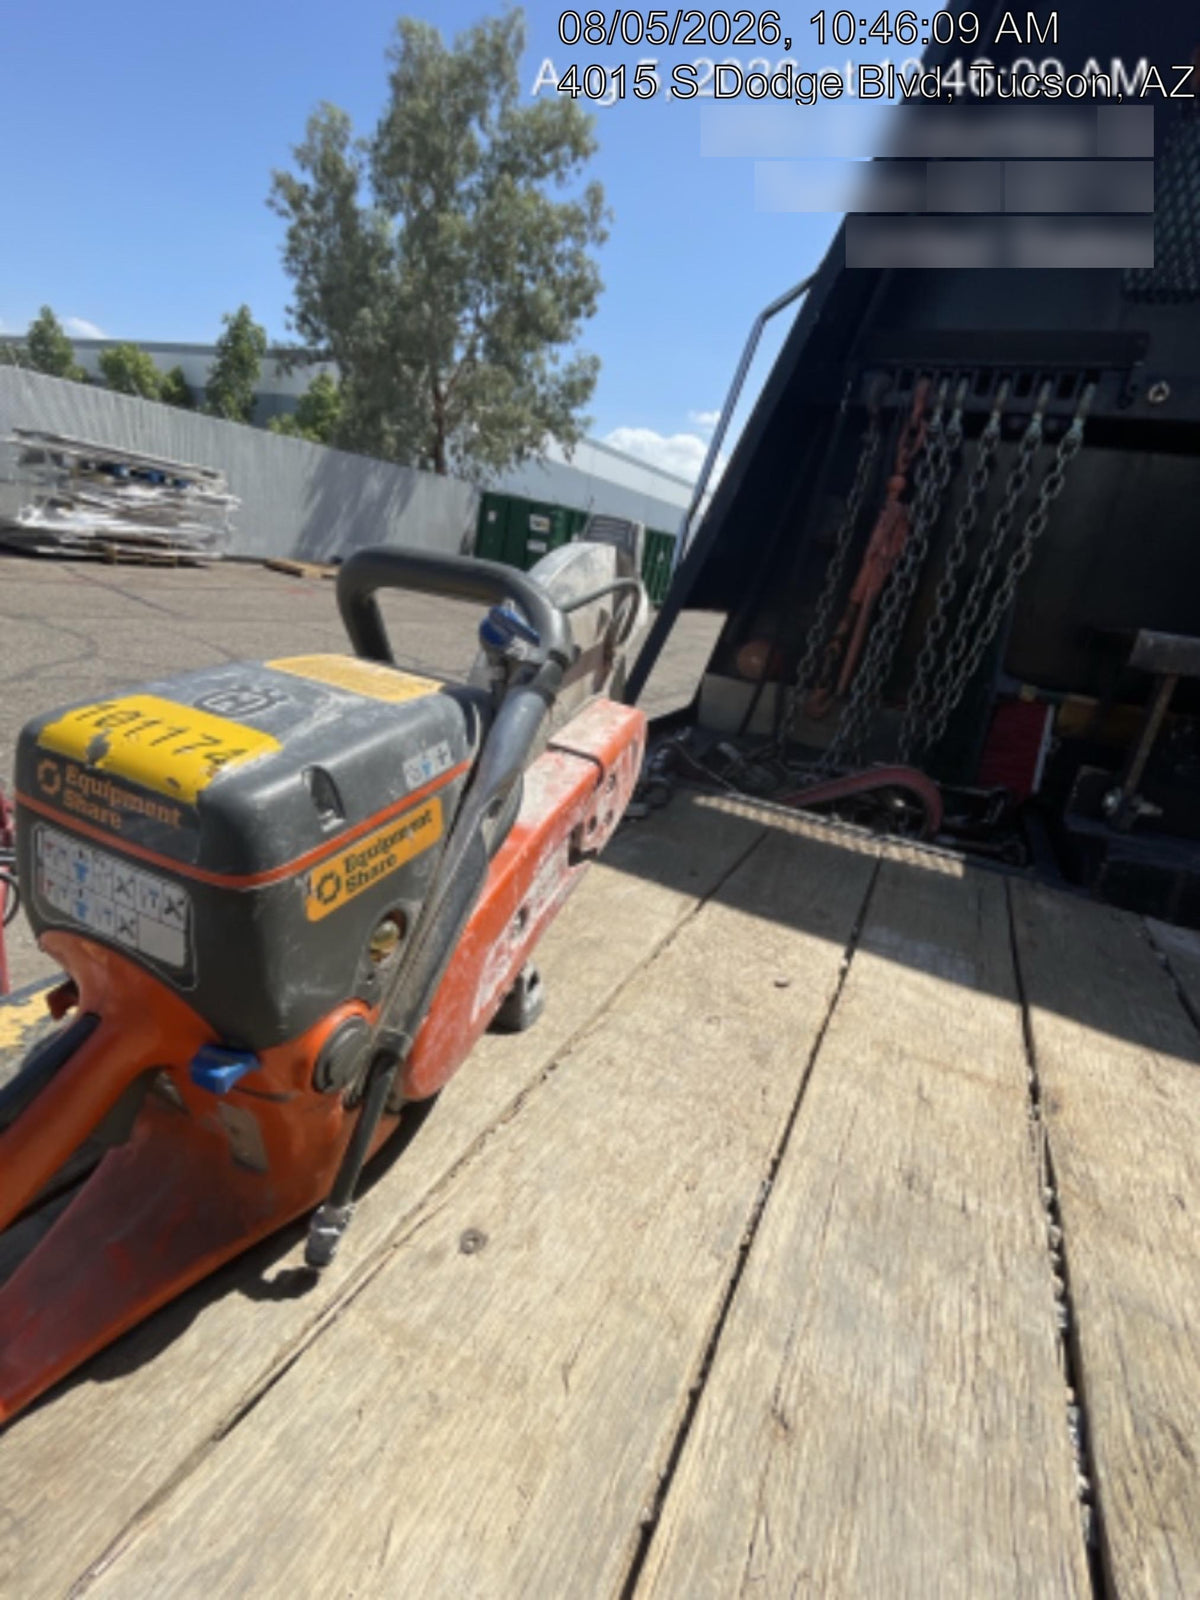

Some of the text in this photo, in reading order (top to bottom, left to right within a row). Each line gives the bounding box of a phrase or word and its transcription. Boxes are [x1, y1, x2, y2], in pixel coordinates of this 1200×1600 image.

[62, 789, 123, 829] Share
[65, 763, 182, 829] Equipment
[345, 853, 398, 894] Share
